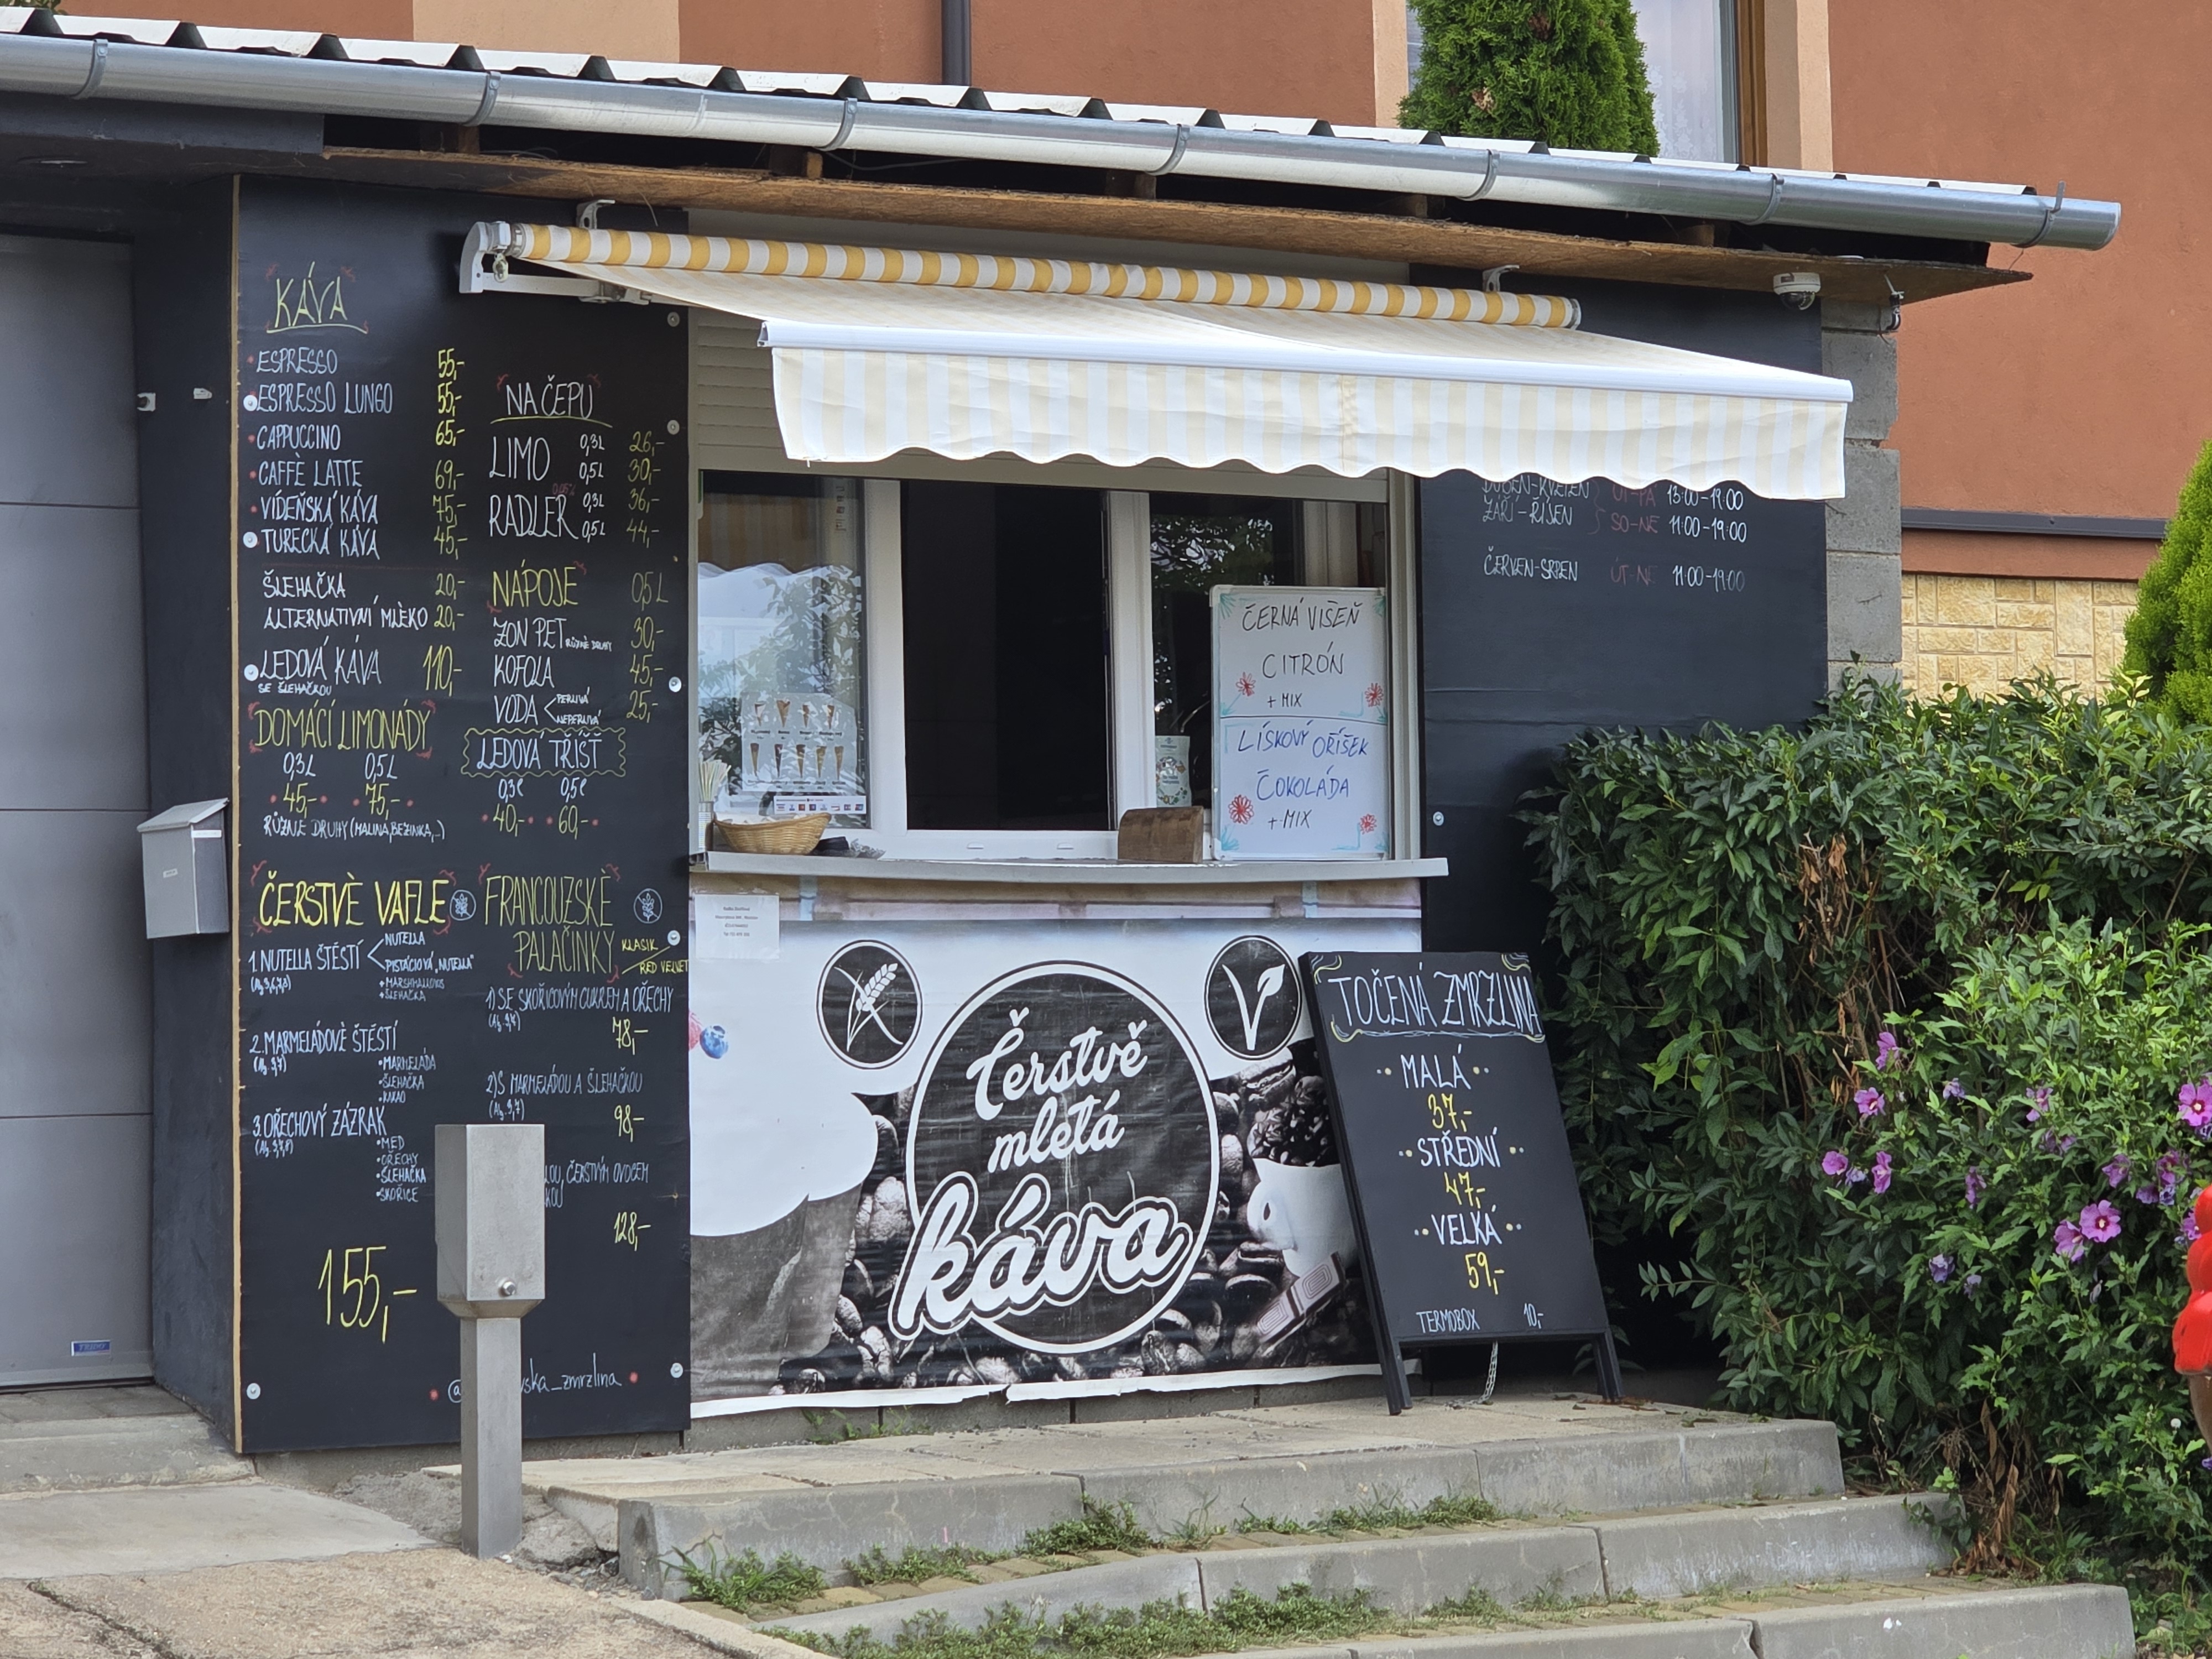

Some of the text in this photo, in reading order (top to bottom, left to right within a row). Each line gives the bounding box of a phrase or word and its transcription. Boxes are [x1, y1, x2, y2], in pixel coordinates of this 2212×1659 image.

[275, 262, 348, 328] KÁVA
[256, 347, 465, 380] ESPRESSO 55,-
[257, 381, 462, 416] ESPRESSO LUNGO 55,-
[506, 374, 593, 419] NA ČEPU
[257, 419, 465, 450] CAPPUCCINO 65,-
[489, 431, 665, 481] LIMO 0,3L 26,-
[579, 457, 661, 486] 0,5L 30,-
[314, 458, 363, 487] LATTE
[435, 460, 465, 491] 69,-
[261, 489, 466, 525] VÍDEŇSKÁ KÁVA 75,-
[489, 487, 660, 540] RADLER 0,3L 36,-
[261, 522, 468, 560] TURECKÁ KÁVA 45,-
[582, 518, 660, 549] 0,5L 44,-
[263, 569, 465, 599] ŠLEHAČKA 20,-
[493, 559, 579, 608] NÁPOJE
[264, 595, 379, 629] ALTERNATIVNÍ
[434, 604, 465, 630] 20,-
[1242, 597, 1363, 631] ČERNÁ VIŠEŇ
[532, 617, 567, 649] PET
[630, 616, 665, 652] 30,-
[260, 635, 462, 697] LEDOVÁ KÁVA 110,-
[494, 654, 664, 688] KOFOLA 45,-
[1262, 641, 1344, 679] CITRÓN
[258, 681, 332, 696] SE ŠLEHAČKOU
[1281, 693, 1302, 708] MIX
[254, 699, 431, 751] DOMÁCÍ LIMONÁDY
[494, 693, 538, 726] VODA
[626, 690, 659, 723] 25,-
[476, 729, 603, 769] LEDOVÁ TŘÍŠŤ
[1238, 720, 1369, 758] LÍSKOVÝ OŘÍŠEK
[283, 782, 400, 820] 45,- 75,-
[1256, 765, 1350, 801] ČOKOLÁDA
[311, 819, 347, 841] DRUHY
[493, 803, 589, 840] 40,- 60,-
[374, 879, 449, 926] VAFLE
[260, 948, 312, 973] NUTELLA
[316, 939, 364, 971] ŠTĚSTÍ
[384, 931, 426, 947] NUTELLA
[513, 925, 615, 975] PALAČINKY
[622, 938, 659, 952] KLASIK
[384, 951, 434, 973] PISTÁCIOVÁ
[639, 959, 688, 975] RED VELVET
[497, 987, 515, 1011] SE
[518, 982, 578, 1012] SKOŘICOVÝM
[578, 987, 620, 1012] CUKREM
[621, 987, 630, 1013] A
[632, 980, 674, 1013] OŘECHY
[1328, 962, 1544, 1035] TOČENÁ ZMRZLINA
[352, 1020, 399, 1053] ŠTĚSTÍ
[612, 1016, 649, 1056] 78,-
[510, 1064, 572, 1095] MARMELÁDOU
[573, 1072, 582, 1094] A
[587, 1067, 643, 1094] ŠLEHAČKOU
[966, 1006, 1149, 1121] Čerstvě
[1400, 1043, 1472, 1091] MALÁ
[383, 1090, 406, 1104] KAKAO
[1427, 1093, 1473, 1133] 37,-
[264, 1103, 327, 1138] OŘECHOVÝ
[331, 1101, 387, 1137] ZÁZRAK
[614, 1104, 645, 1142] 98,-
[987, 1089, 1125, 1173] mletá
[380, 1135, 405, 1151] MED
[380, 1150, 419, 1166] OŘECHY
[1417, 1126, 1501, 1167] STŘEDNÍ
[380, 1164, 426, 1183] ŠLEHAČKA
[566, 1155, 609, 1185] ČERSTVÝM
[613, 1162, 649, 1184] OVOCEM
[380, 1183, 419, 1202] SKOŘICE
[1443, 1171, 1486, 1210] 47,-
[613, 1211, 651, 1252] 128,-
[1431, 1204, 1503, 1245] VELKÁ
[889, 1171, 1193, 1340] káva
[1464, 1251, 1505, 1296] 59,-
[318, 1246, 417, 1344] 155,-
[1416, 1303, 1545, 1334] TERMOBOX 10,-
